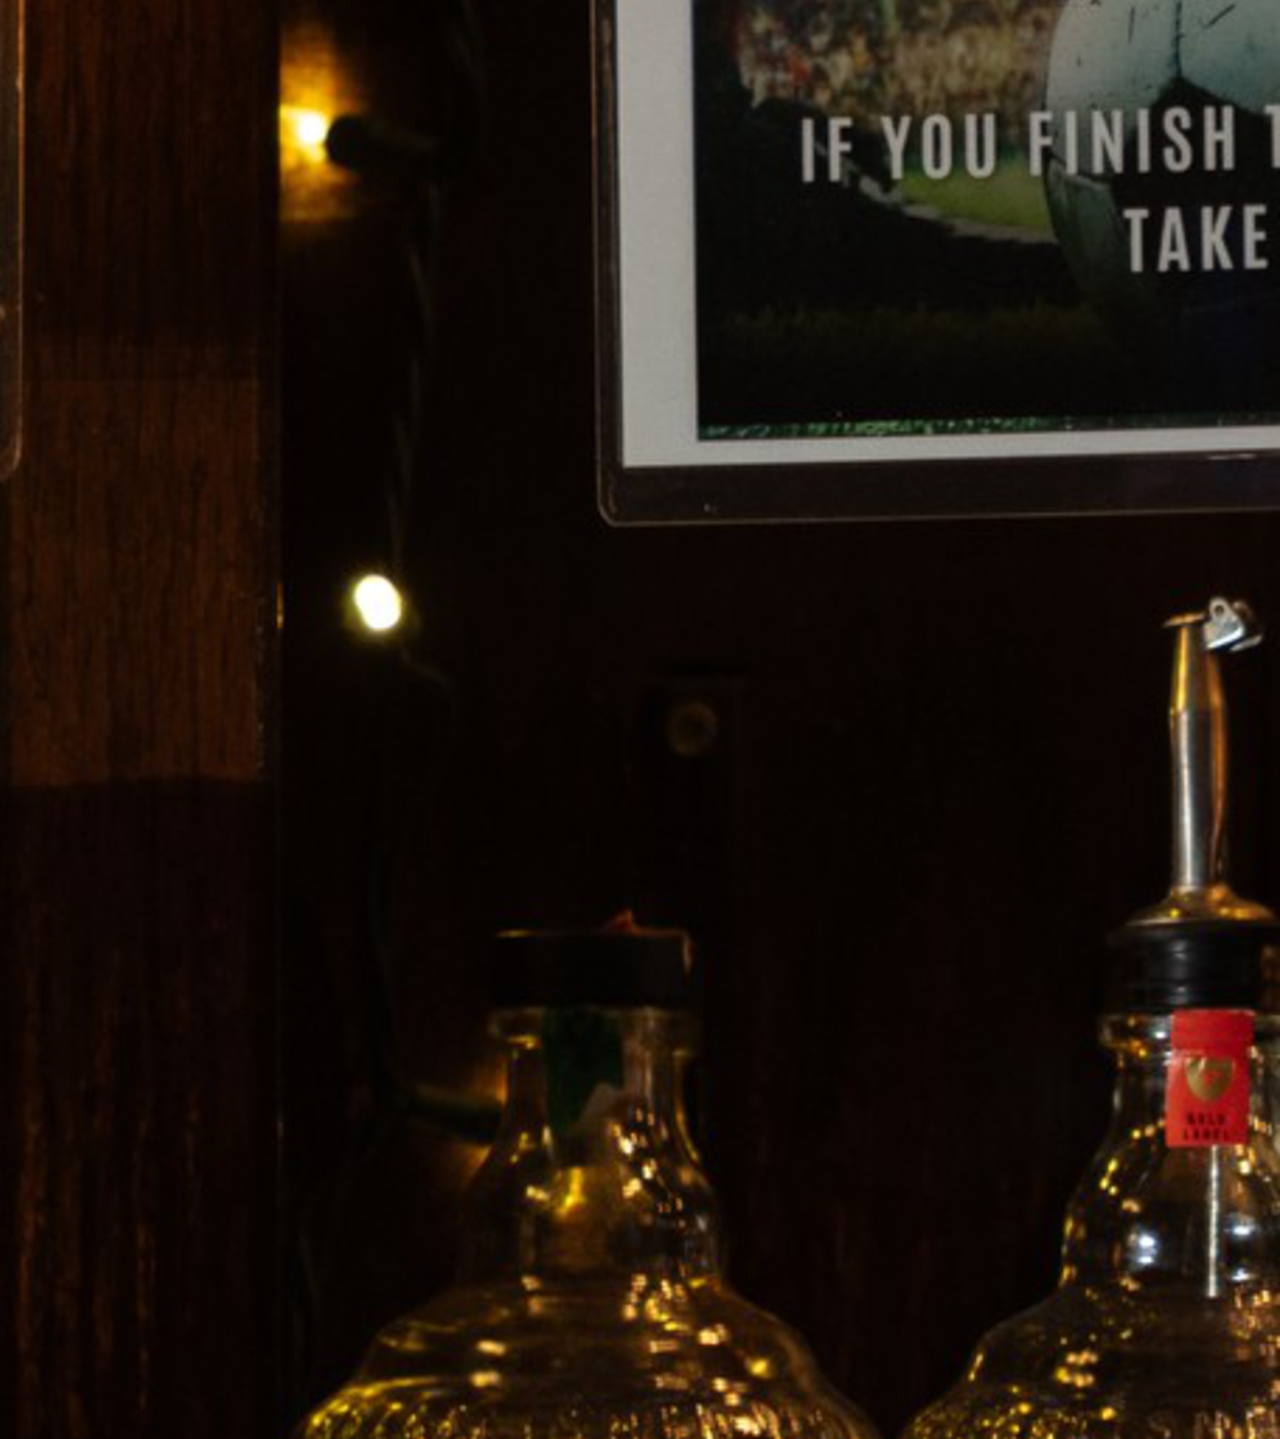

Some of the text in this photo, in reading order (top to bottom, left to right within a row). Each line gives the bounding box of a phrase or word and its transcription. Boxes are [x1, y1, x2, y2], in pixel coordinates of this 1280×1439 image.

[800, 116, 855, 184] IF
[880, 112, 998, 181] YOU
[1028, 103, 1238, 178] FINISH
[1121, 203, 1270, 274] TAKE
